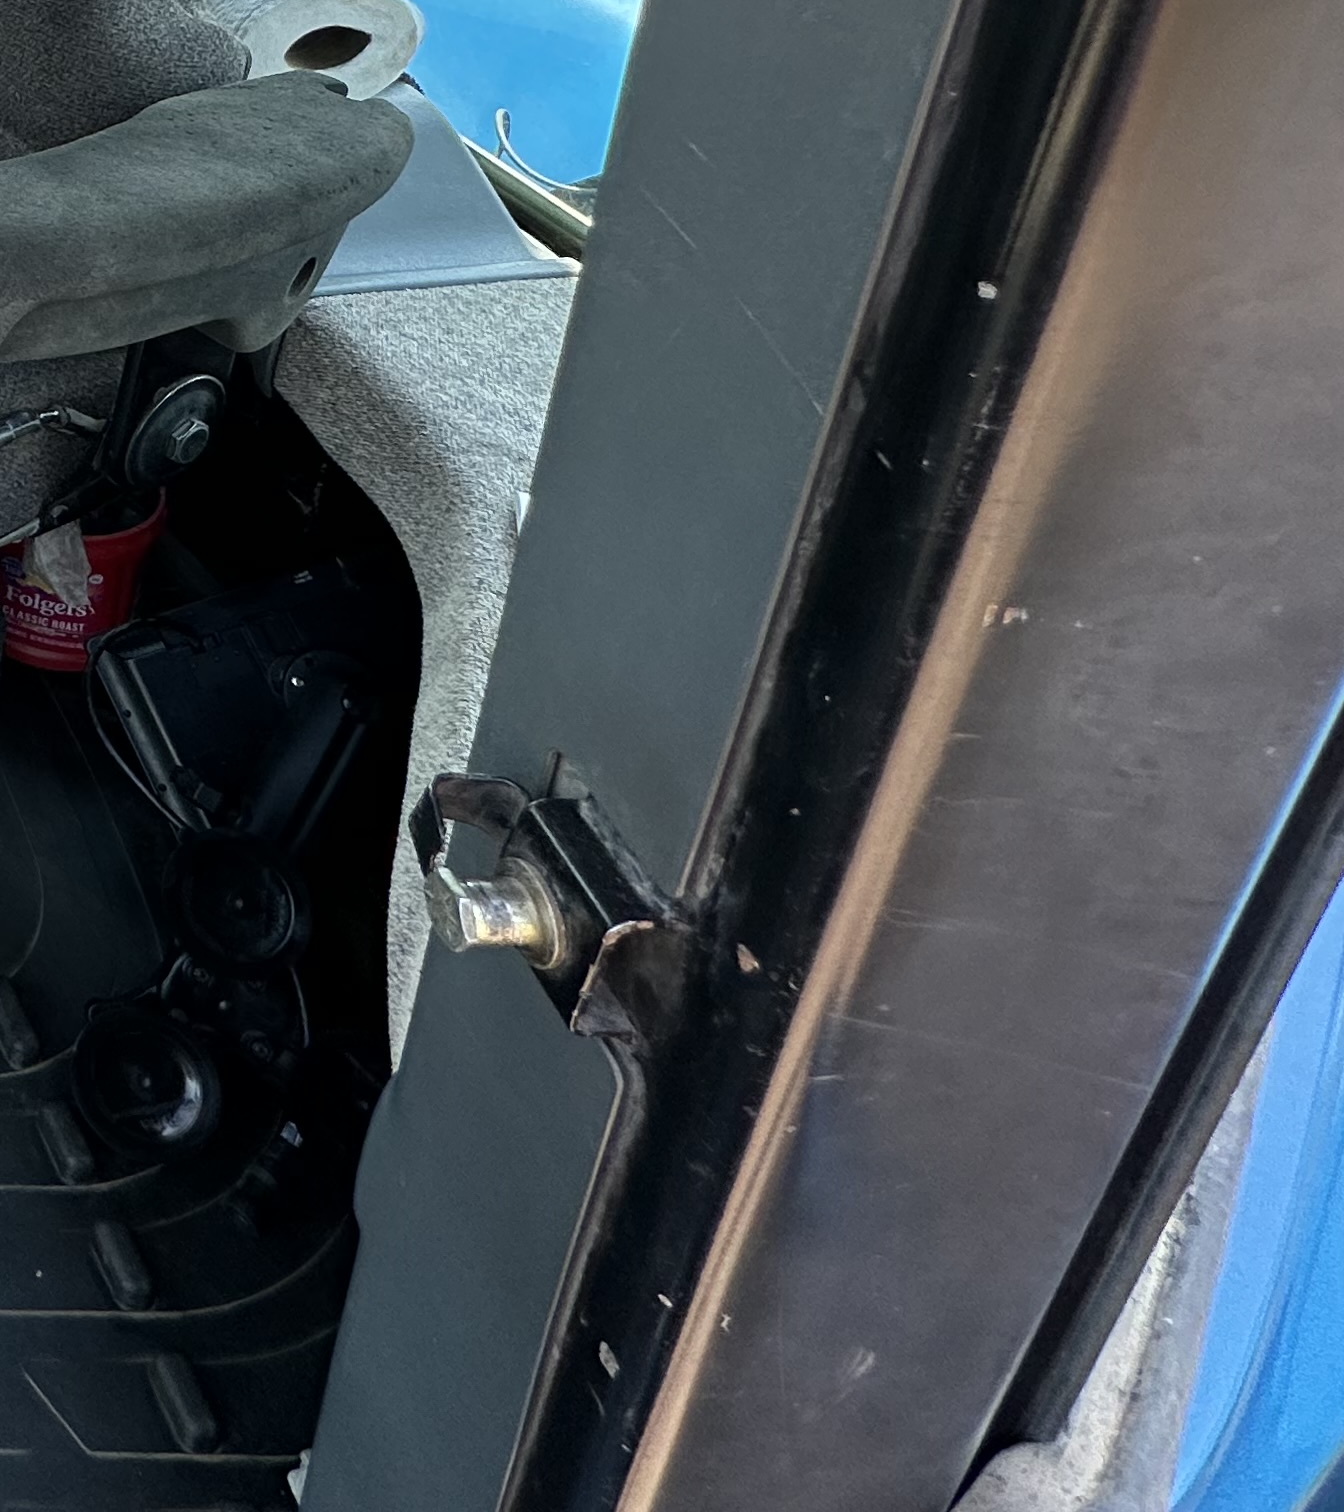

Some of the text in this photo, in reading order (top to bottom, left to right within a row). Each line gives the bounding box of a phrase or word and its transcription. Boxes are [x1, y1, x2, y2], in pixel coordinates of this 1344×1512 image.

[4, 584, 88, 617] Folgers
[2, 604, 49, 627] CLASSIC
[51, 619, 86, 632] ROAST
